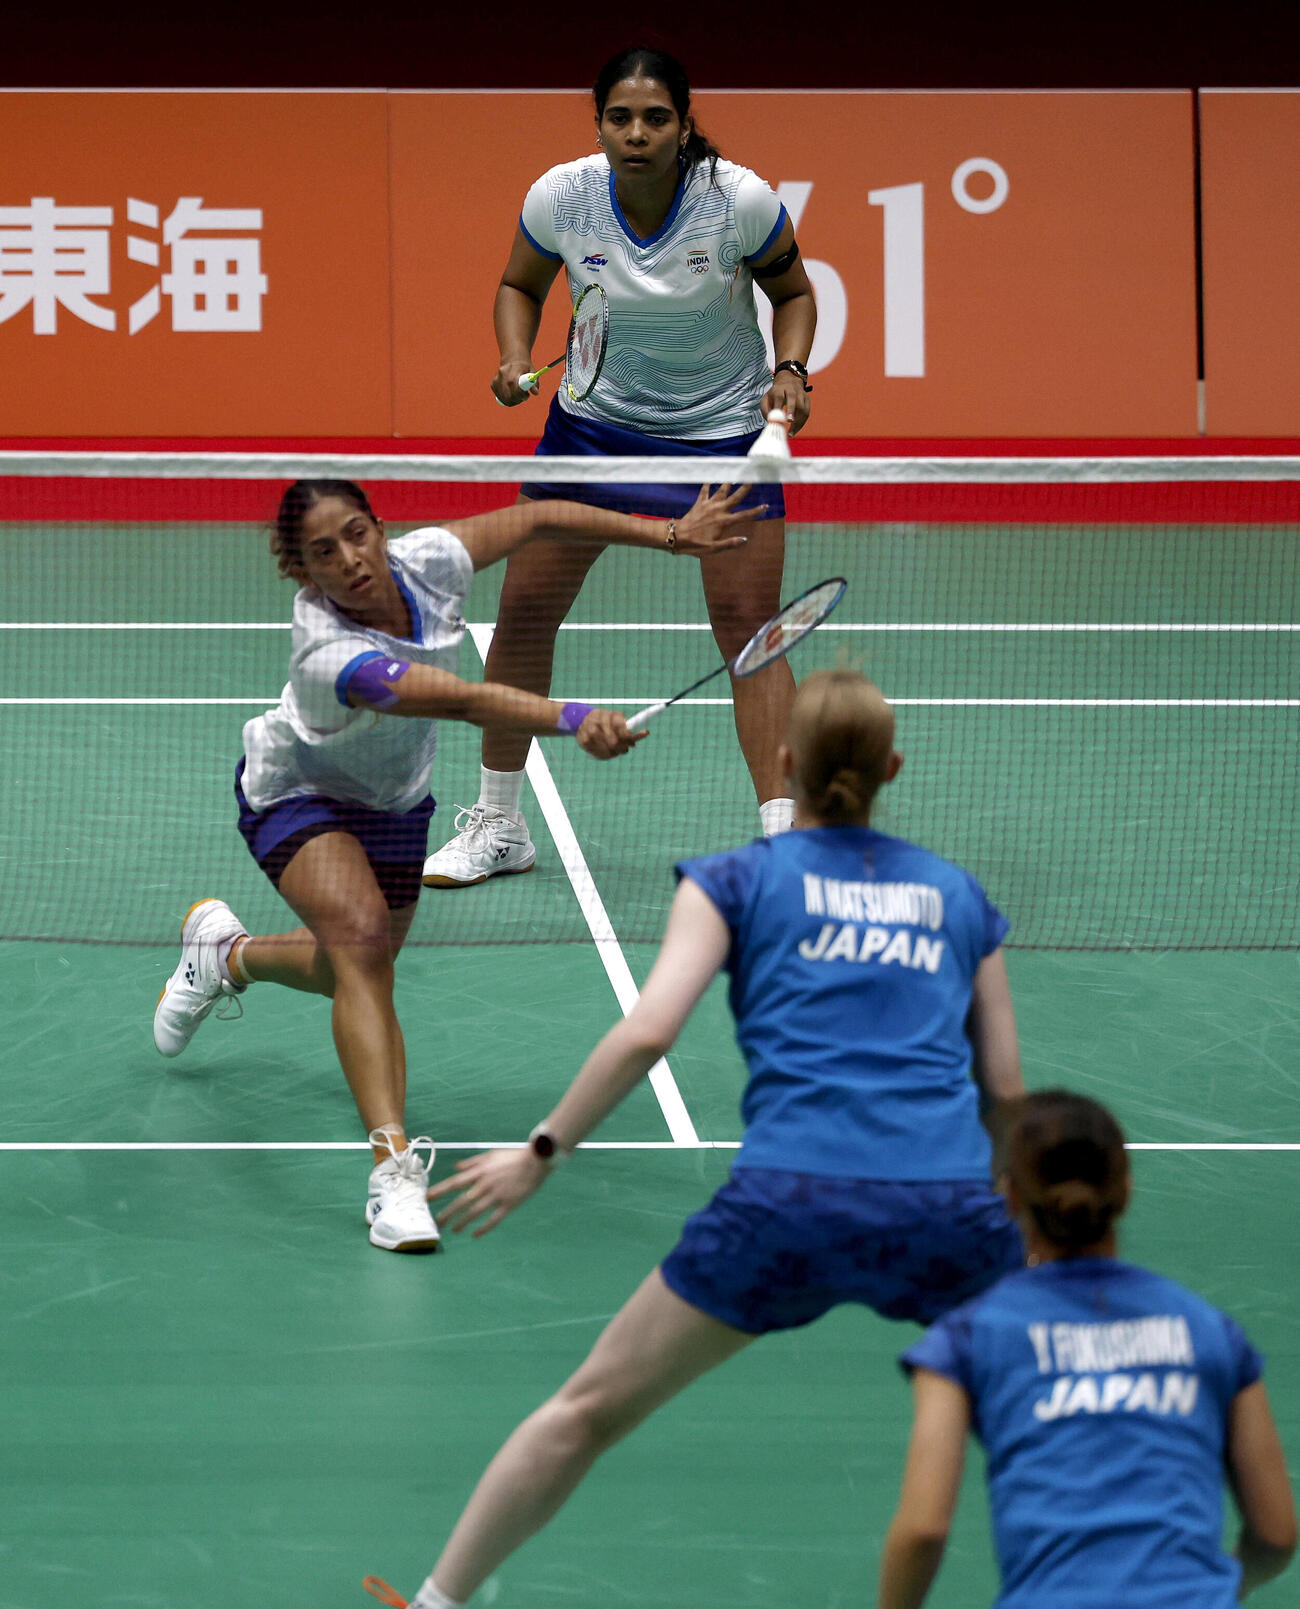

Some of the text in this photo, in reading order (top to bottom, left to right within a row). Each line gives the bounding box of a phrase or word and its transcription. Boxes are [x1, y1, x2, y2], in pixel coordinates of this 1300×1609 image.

[579, 255, 609, 266] JSW
[687, 256, 710, 267] INDIA
[824, 877, 944, 931] MATSUMOTO
[798, 922, 945, 974] JAPAN
[1033, 1371, 1199, 1421] JAPAN
